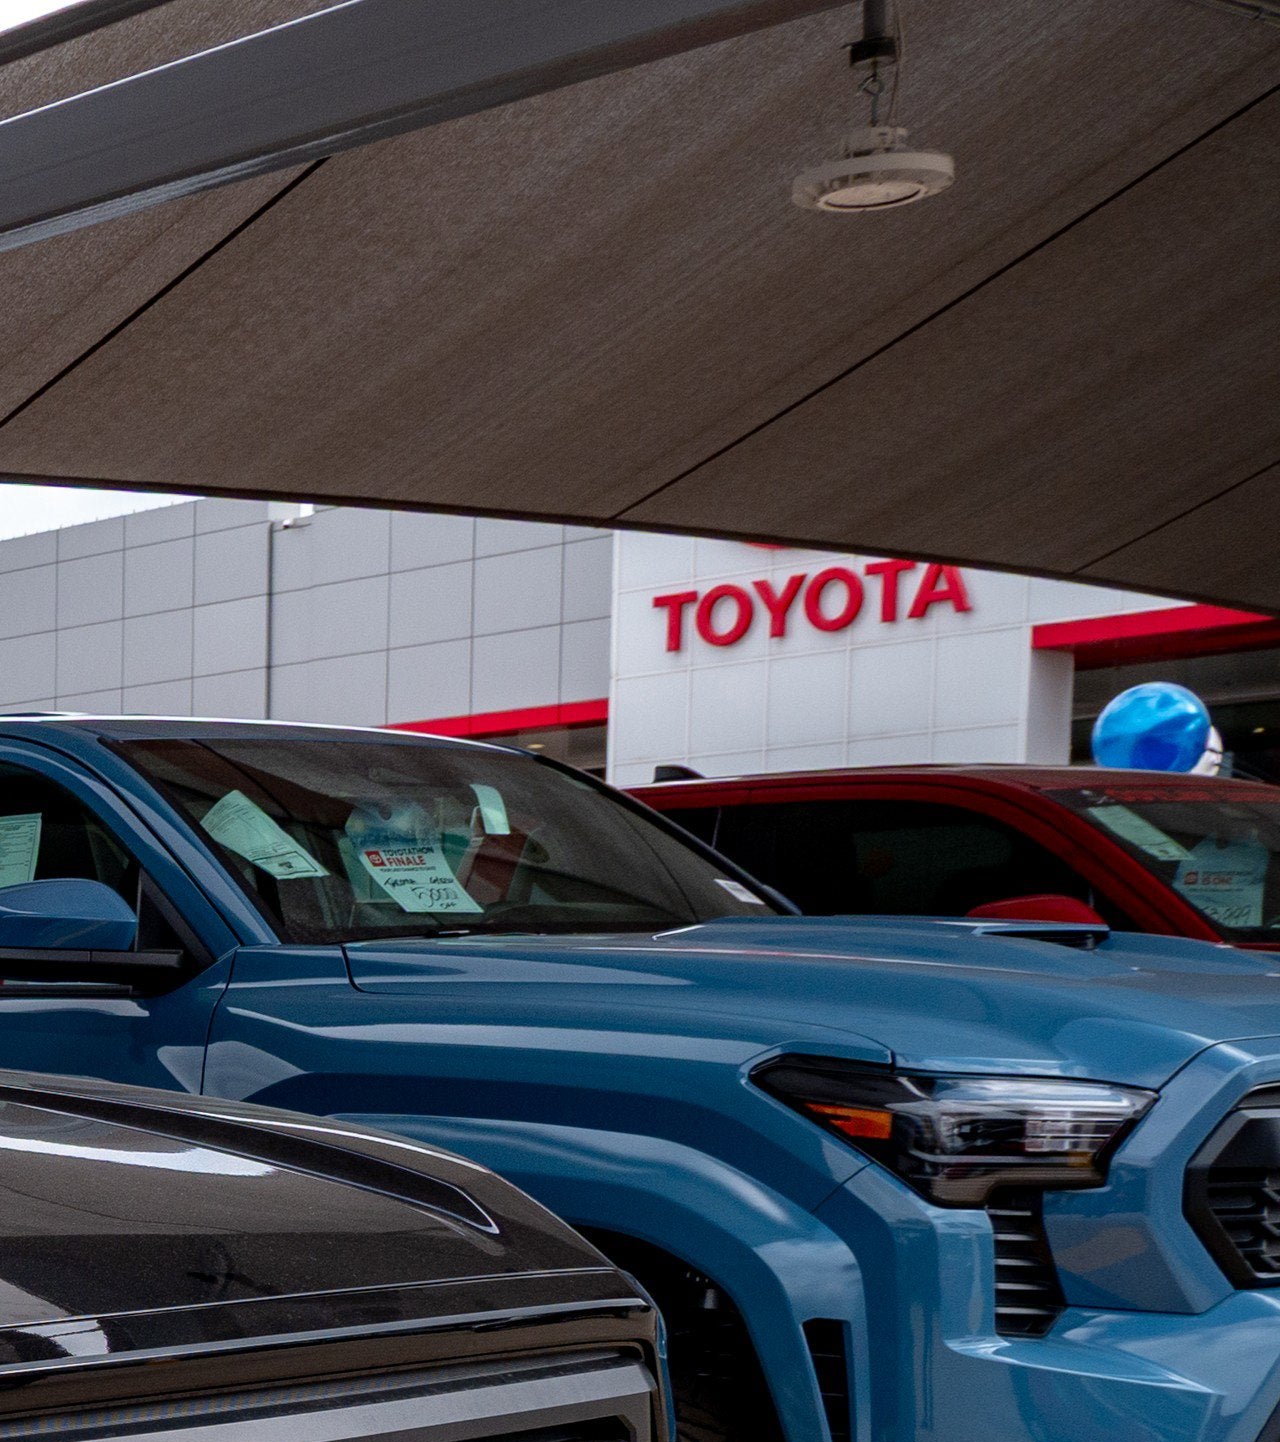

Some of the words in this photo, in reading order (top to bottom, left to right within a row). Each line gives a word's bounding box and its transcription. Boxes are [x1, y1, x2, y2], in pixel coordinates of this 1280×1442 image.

[652, 559, 973, 652] TOYOTA
[382, 846, 434, 858] TOYOTATHON
[386, 855, 427, 867] FINALE
